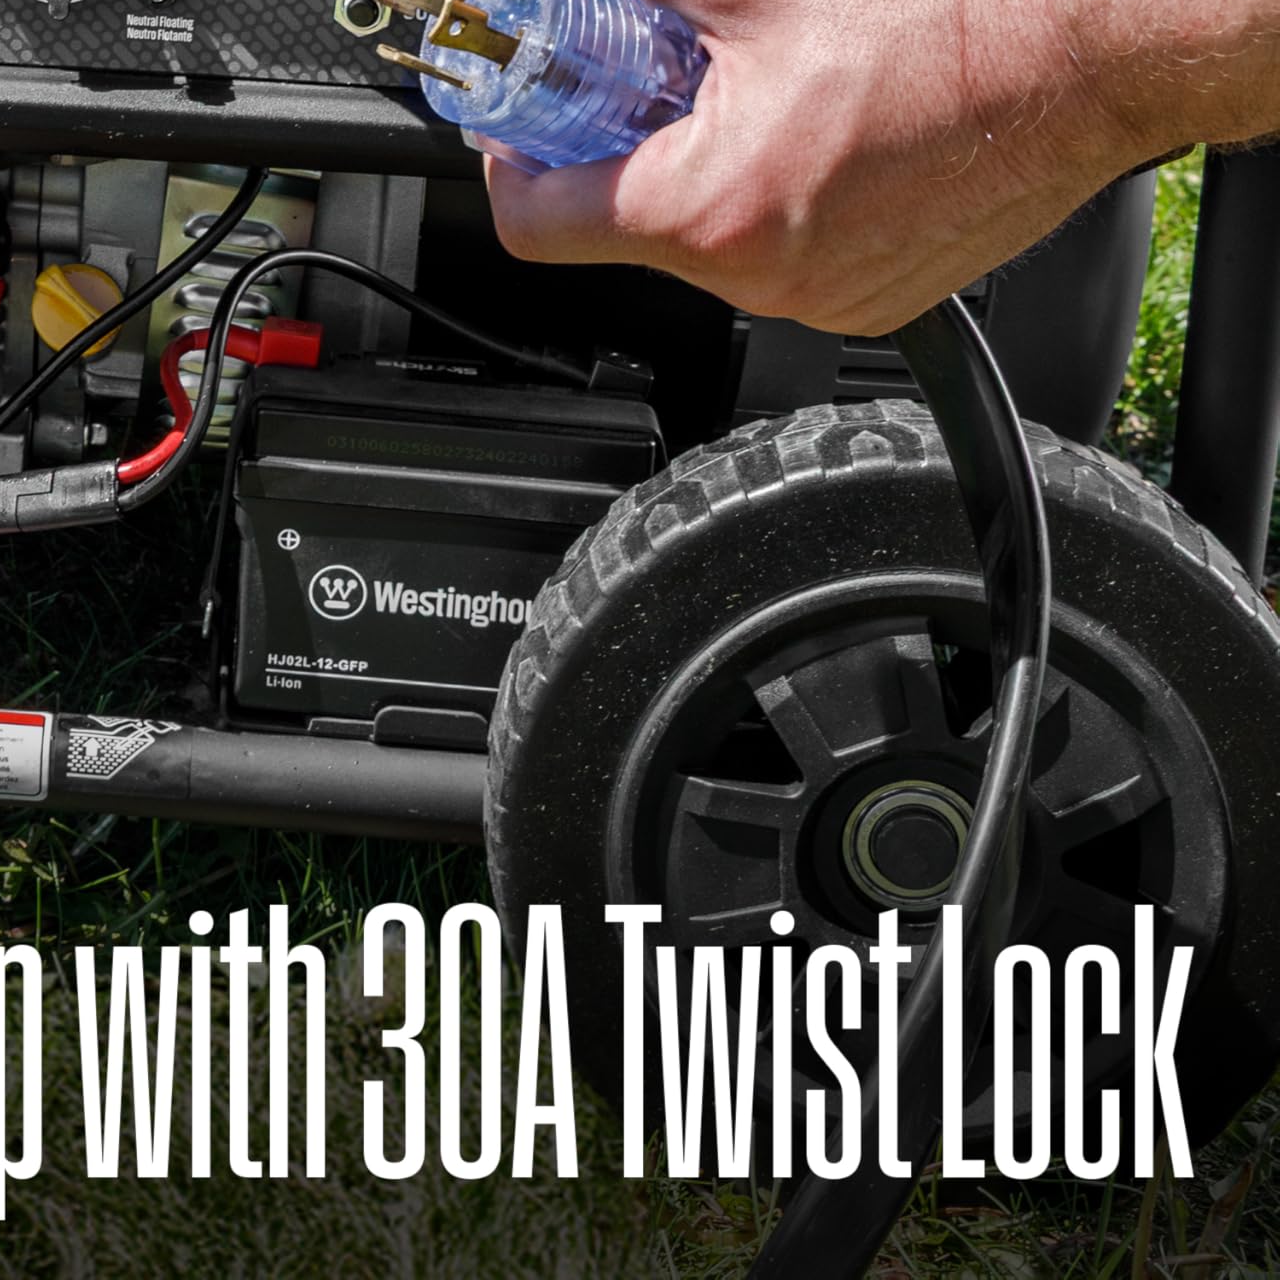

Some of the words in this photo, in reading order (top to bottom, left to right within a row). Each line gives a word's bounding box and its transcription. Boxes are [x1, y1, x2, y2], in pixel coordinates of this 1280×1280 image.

[127, 14, 158, 26] Neutral
[159, 16, 194, 30] Floating
[127, 28, 156, 40] Neutro
[157, 29, 192, 42] Flotante
[268, 653, 368, 672] HJ02L-12-GFP
